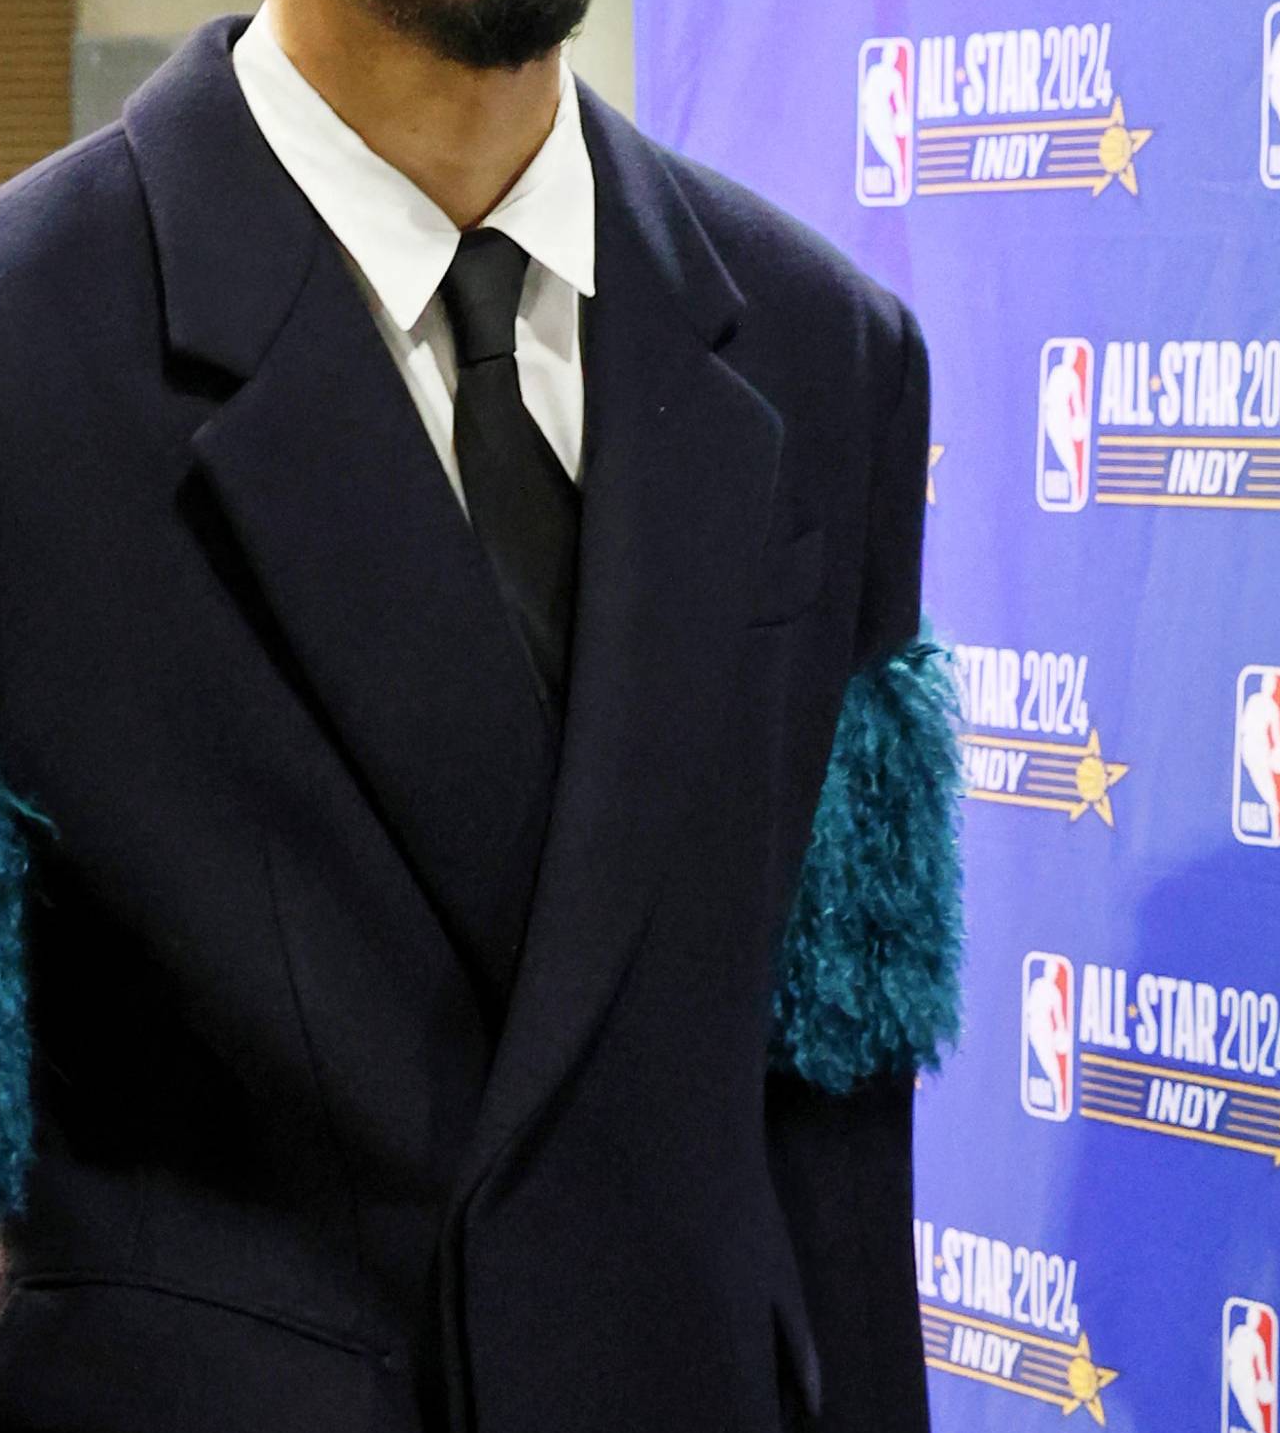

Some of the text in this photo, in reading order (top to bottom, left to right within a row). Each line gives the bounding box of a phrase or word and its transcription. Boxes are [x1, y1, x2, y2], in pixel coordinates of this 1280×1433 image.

[1041, 22, 1114, 112] 2024
[970, 132, 1050, 181] INDY
[1167, 448, 1250, 497] INDY
[1020, 649, 1089, 736] 2024
[1146, 1077, 1228, 1132] INDY
[1012, 1246, 1080, 1338] 2024
[949, 1324, 1021, 1380] INDY
